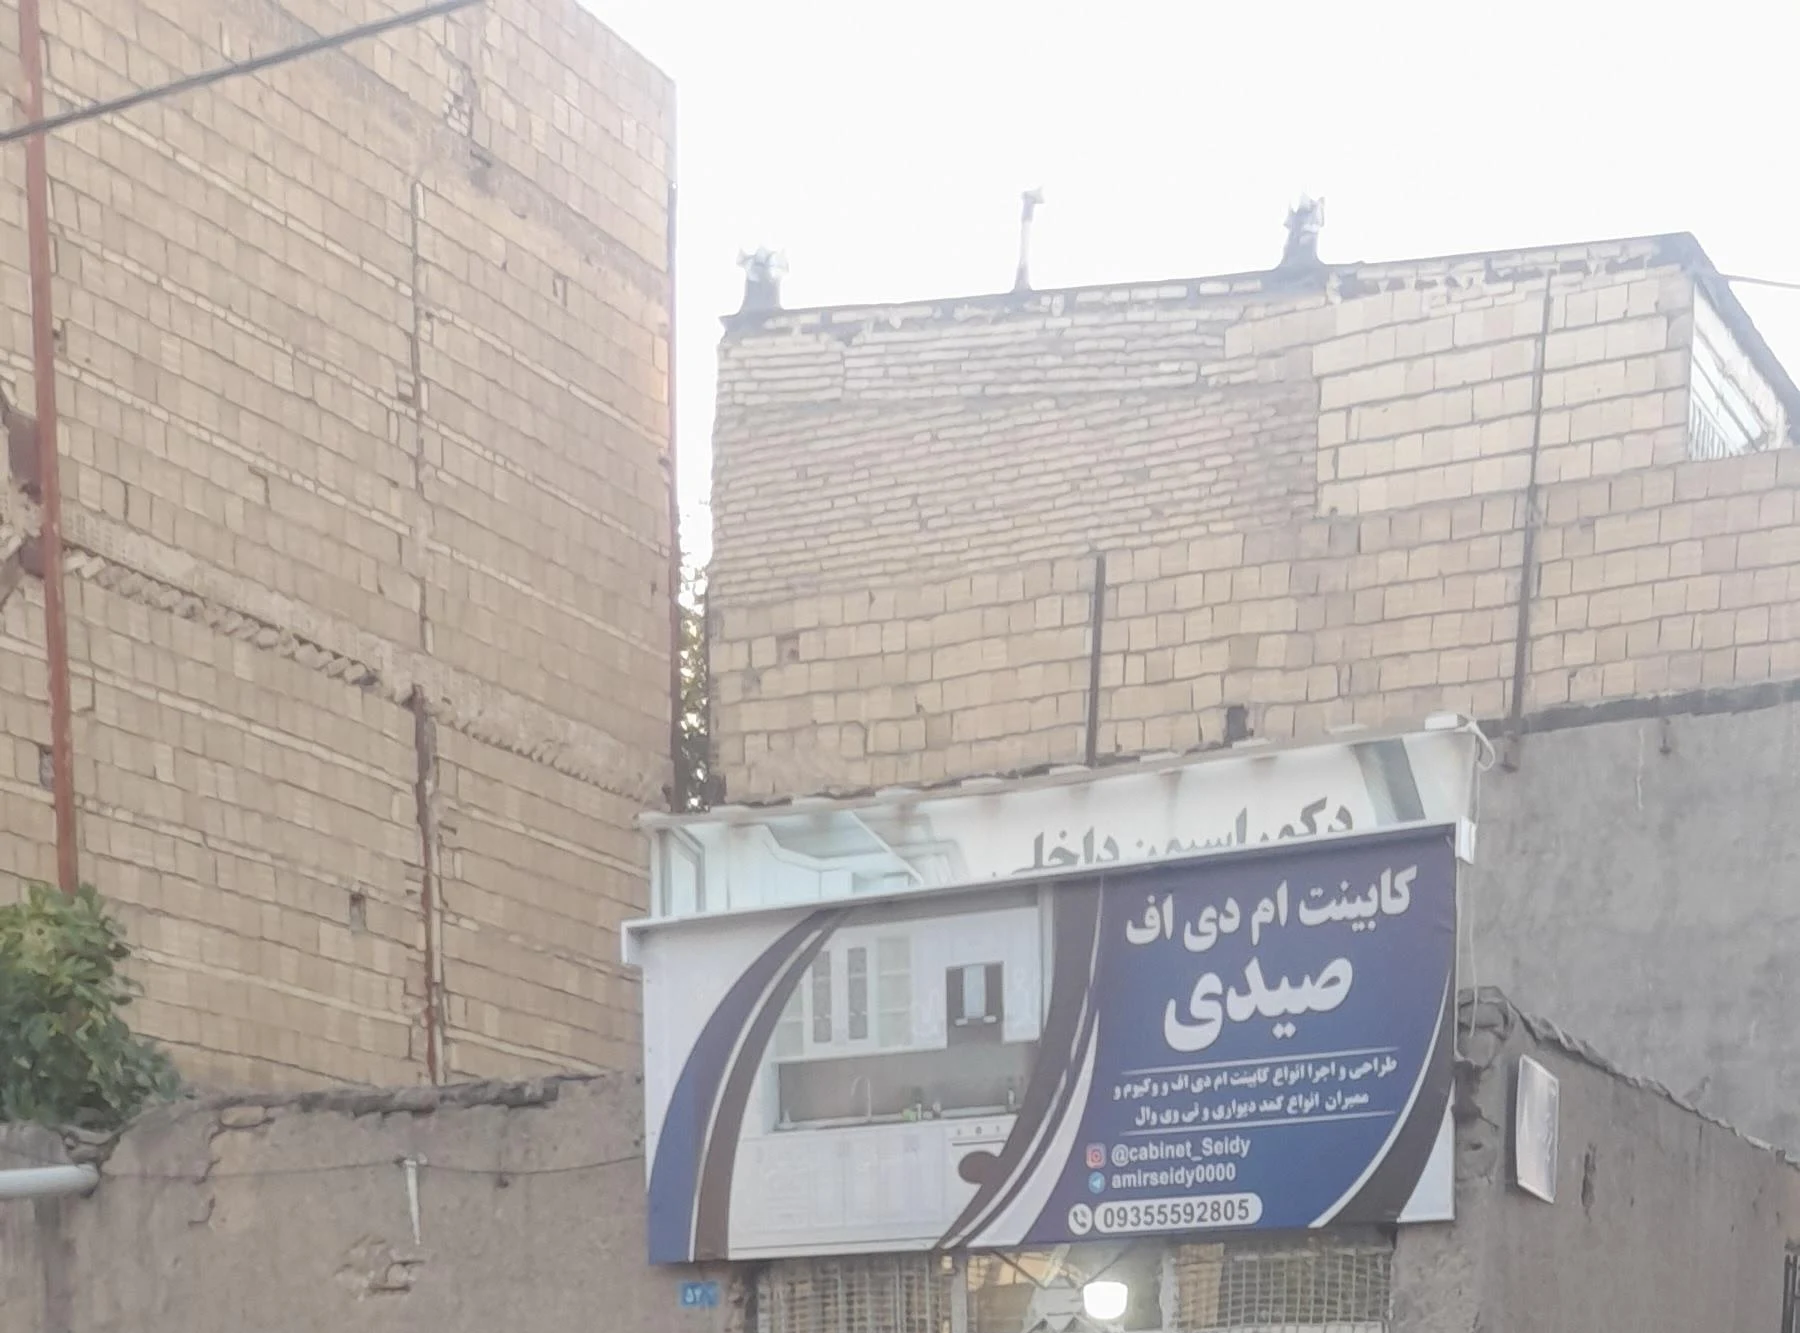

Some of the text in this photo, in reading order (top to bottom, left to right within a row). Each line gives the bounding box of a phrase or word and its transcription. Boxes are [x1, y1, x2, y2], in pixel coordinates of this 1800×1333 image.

[992, 825, 1120, 878] داخل
[1126, 864, 1418, 952] کابینت ام دی اف
[1164, 951, 1354, 1052] صیدی
[1230, 1066, 1270, 1088] کابینت
[1272, 1062, 1305, 1087] انواع
[1308, 1061, 1336, 1083] اجرا
[1338, 1065, 1346, 1081] و
[1349, 1056, 1398, 1079] طراحی
[1113, 1085, 1121, 1100] و
[1161, 1082, 1169, 1097] و
[1172, 1073, 1189, 1092] اف
[1191, 1076, 1211, 1094] دی
[1213, 1071, 1228, 1092] ام
[1212, 1096, 1256, 1120] دیواری
[1259, 1094, 1284, 1113] کمد
[1287, 1091, 1320, 1114] انواع
[1135, 1105, 1157, 1126] وال
[1160, 1108, 1179, 1125] وی
[1201, 1107, 1210, 1121] و
[1111, 1136, 1251, 1167] @cabinet_Seidy
[1111, 1162, 1236, 1188] amirseidy0000
[1103, 1198, 1250, 1229] 09355592805
